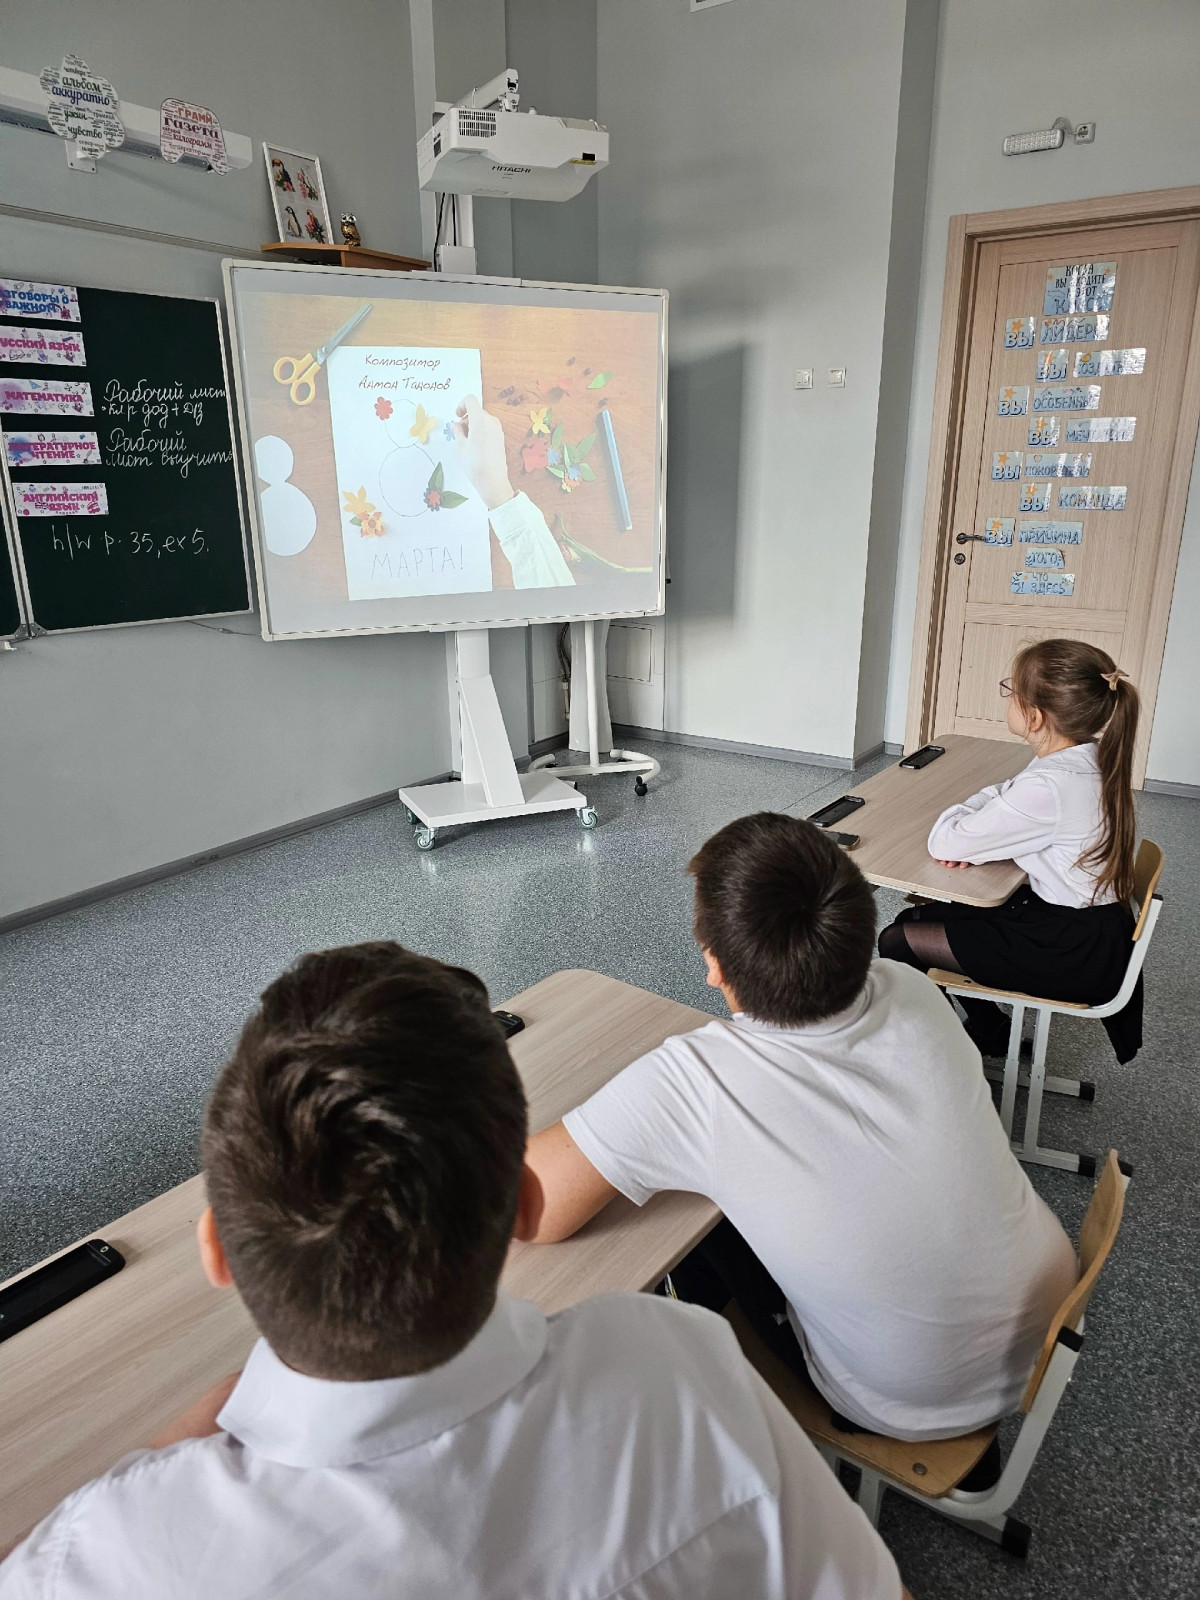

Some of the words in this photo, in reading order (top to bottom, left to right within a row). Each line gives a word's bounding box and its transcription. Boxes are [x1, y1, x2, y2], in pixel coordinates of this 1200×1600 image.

[62, 76, 102, 93] альбом
[51, 86, 110, 106] аккуратно
[64, 109, 88, 122] ужин
[67, 125, 103, 139] чувство
[173, 134, 213, 149] килограмм
[491, 165, 532, 174] HITACHI
[1055, 278, 1068, 289] ВЫ
[0, 289, 60, 304] ЗГОВОРЫ
[6, 301, 58, 313] ВАЖНОМ
[48, 341, 81, 352] ЯЗЫК
[1005, 331, 1035, 348] ВЫ
[365, 353, 441, 371] Композитор
[1036, 363, 1067, 380] ВЫ
[358, 374, 399, 390] Антон
[5, 390, 84, 403] МАТЕМАТИКА
[103, 378, 184, 403] Рабочий
[997, 400, 1027, 416] ВЫ
[106, 427, 187, 452] Рабочий
[1028, 429, 1058, 446] ВЫ
[31, 450, 76, 460] ЧТЕНИЕ
[992, 465, 1021, 480] ВЫ
[23, 491, 98, 503] АНГЛИЙСКИЙ
[1020, 497, 1050, 512] ВЫ
[1058, 493, 1126, 511] КОМАНДА
[47, 502, 80, 512] ЯЗЫК
[51, 523, 92, 561] h/w
[985, 530, 1013, 545] ВЫ
[1019, 530, 1080, 545] ПРИЧИНА
[370, 544, 464, 581] МАРТА!
[1030, 582, 1066, 595] ЗДЕСЬ
